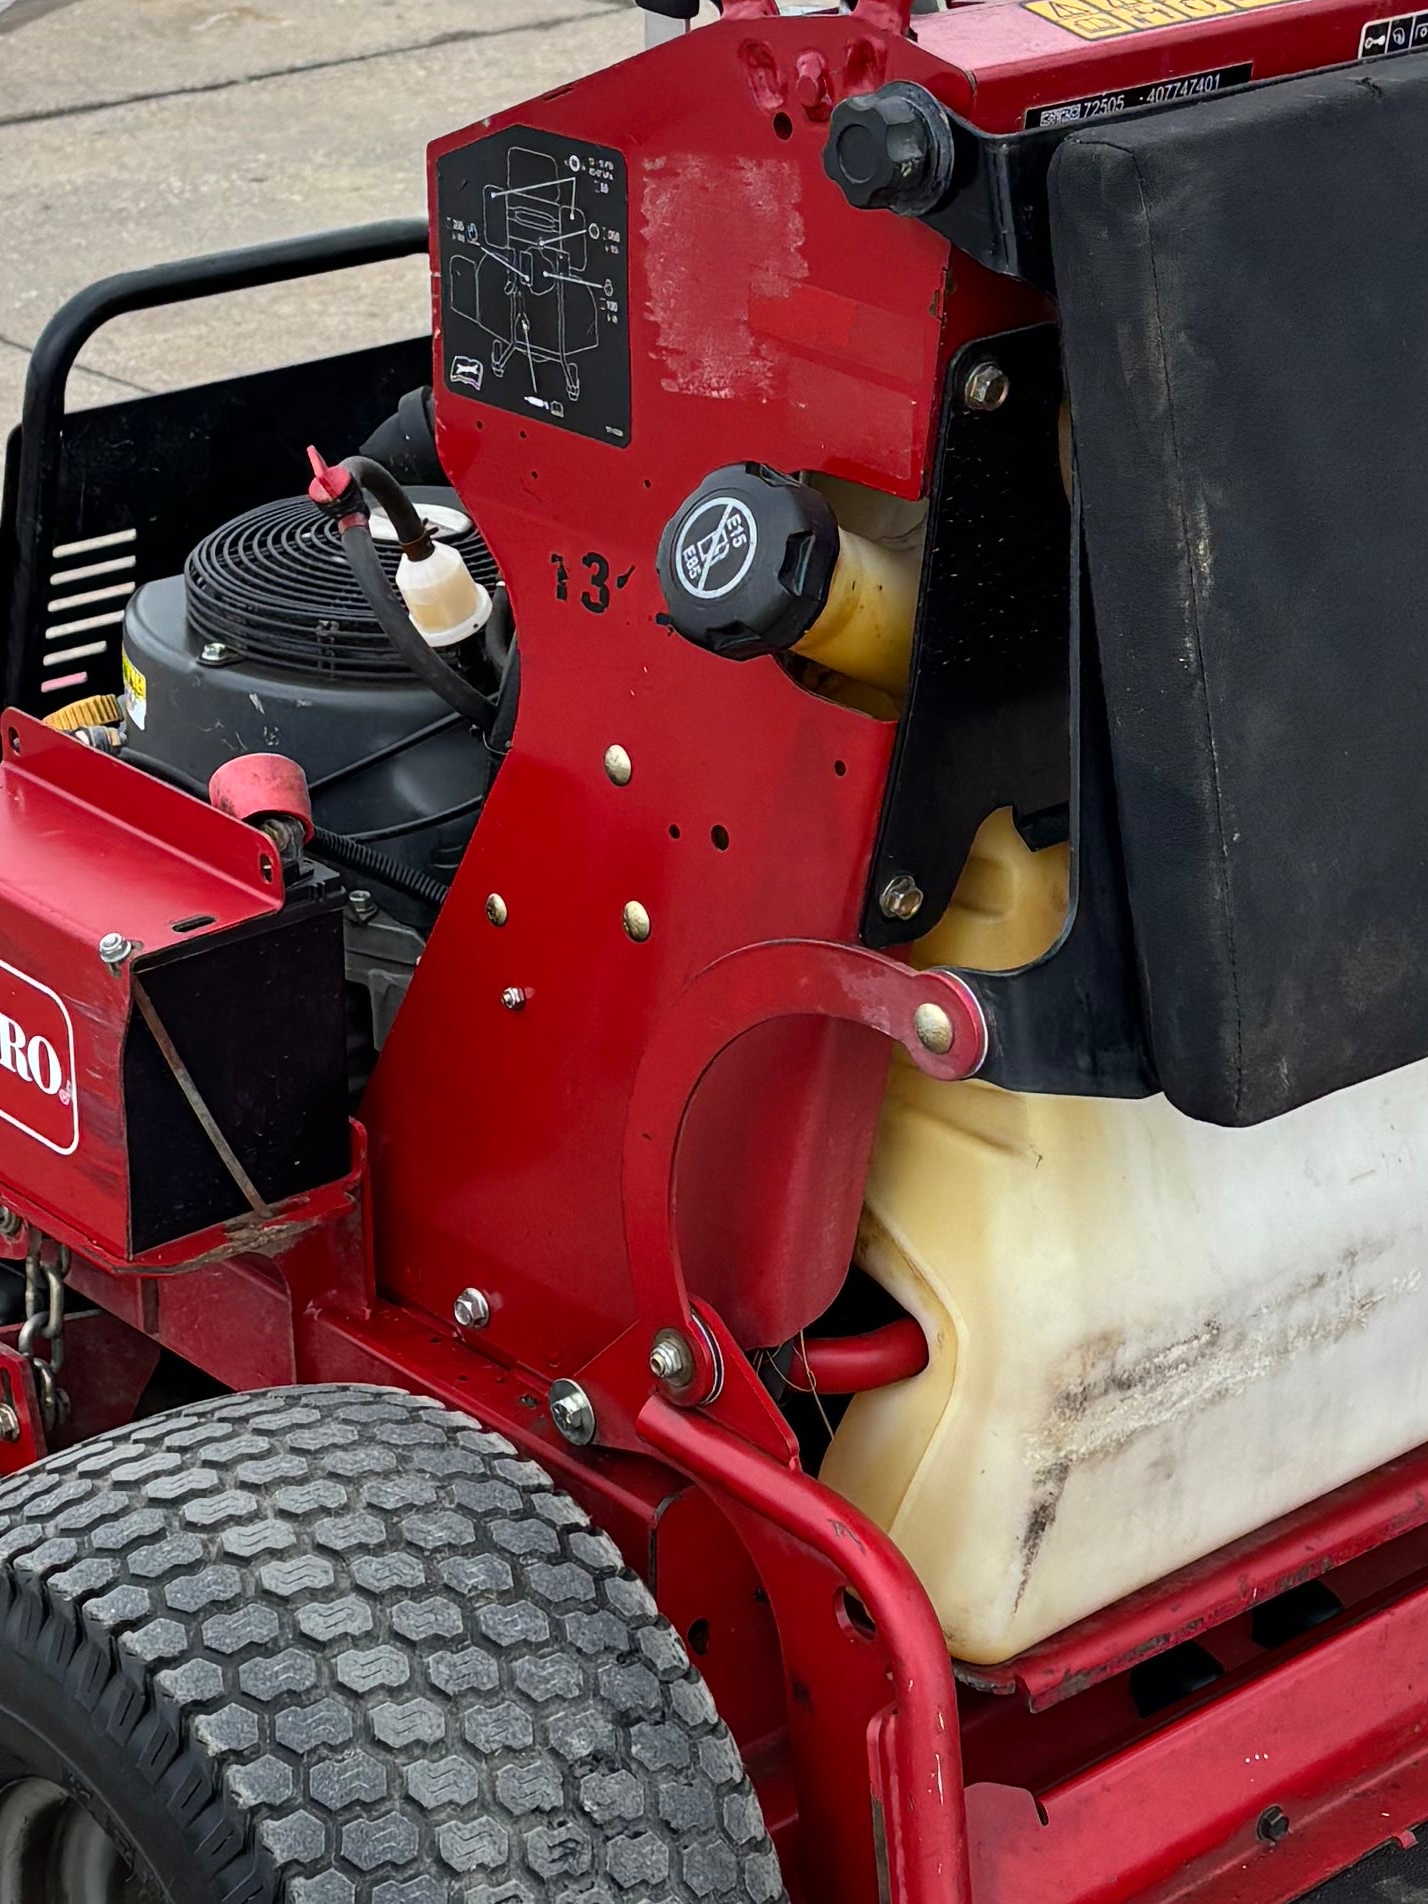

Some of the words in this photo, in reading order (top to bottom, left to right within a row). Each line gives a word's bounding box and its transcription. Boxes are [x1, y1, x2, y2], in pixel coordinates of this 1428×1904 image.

[1083, 95, 1125, 119] 72505
[1147, 73, 1221, 104] 407747401
[725, 512, 747, 549] E15
[683, 544, 703, 580] E85
